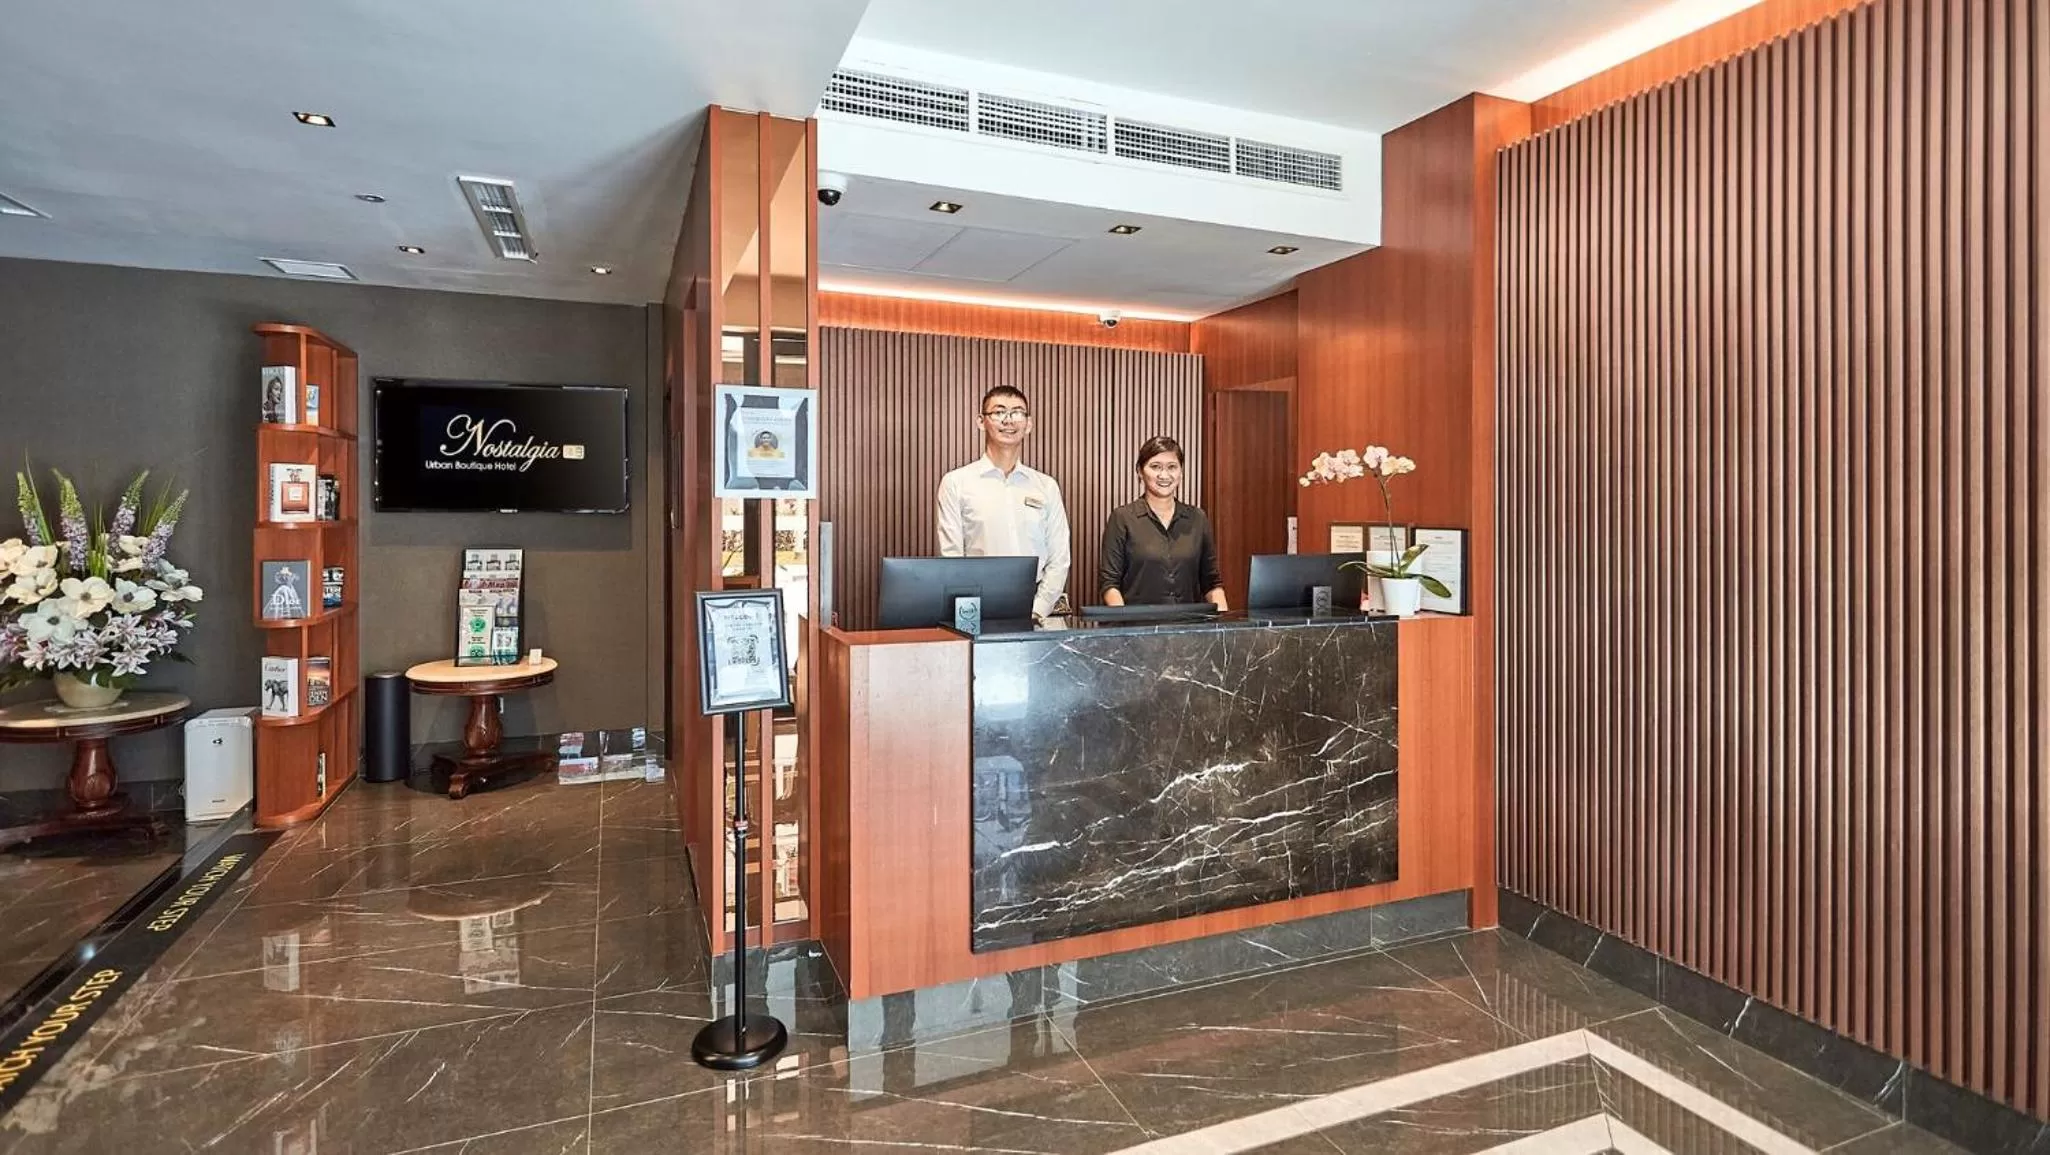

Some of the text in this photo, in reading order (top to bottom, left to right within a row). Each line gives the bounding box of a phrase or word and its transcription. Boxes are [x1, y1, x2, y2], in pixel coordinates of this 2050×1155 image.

[440, 414, 560, 472] Nostalgia
[425, 460, 516, 472] Urban Boutique Hotel
[169, 881, 217, 908] YOUR
[146, 907, 189, 931] STEP
[20, 1000, 93, 1046] YOUR
[69, 969, 123, 1001] STEP
